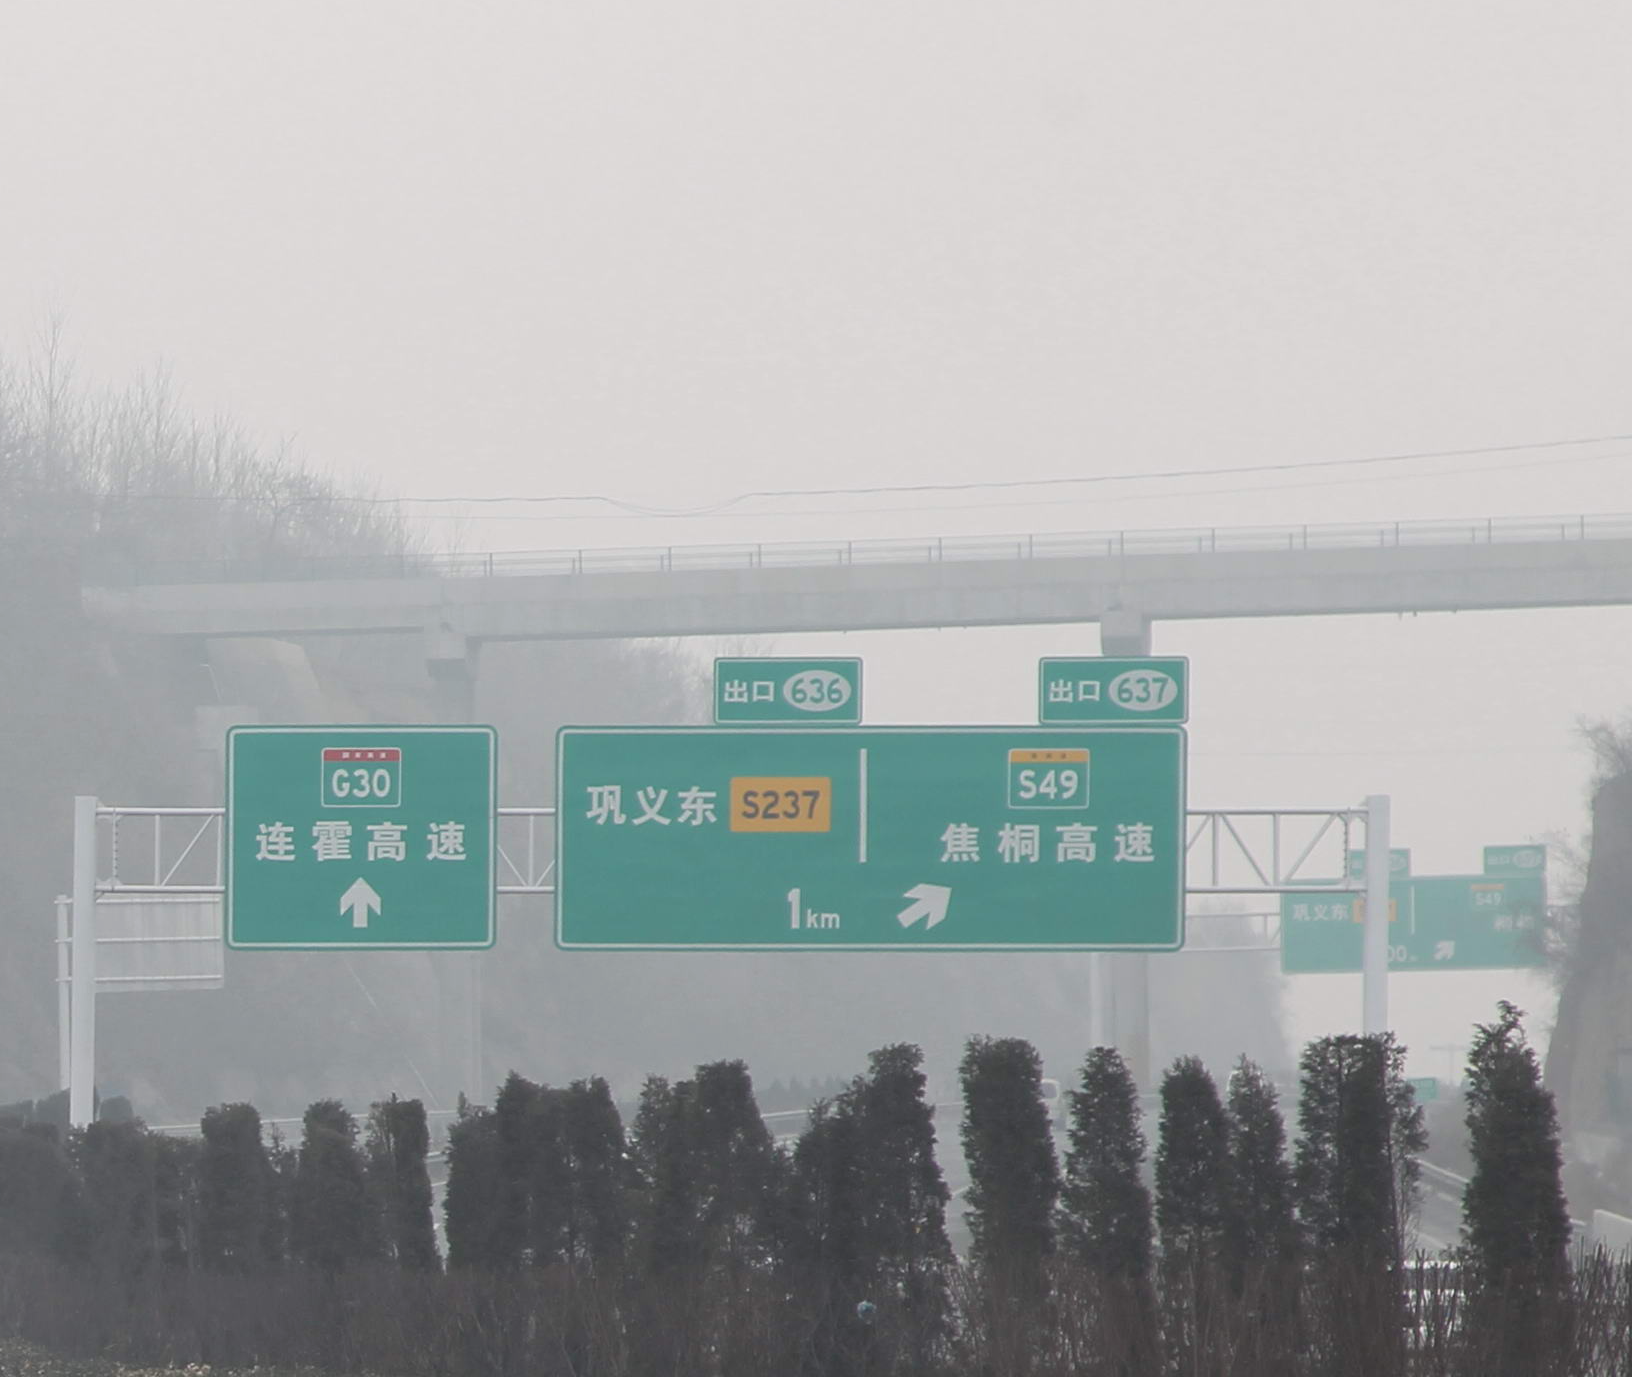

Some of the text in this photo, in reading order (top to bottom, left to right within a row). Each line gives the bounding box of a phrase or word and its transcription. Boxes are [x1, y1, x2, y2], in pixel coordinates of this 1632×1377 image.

[723, 678, 844, 704] 出口 636
[1049, 678, 1168, 704] 出口 637
[331, 768, 391, 798] G30
[1019, 769, 1079, 799] S49
[585, 785, 821, 826] 巩义东 S237
[255, 821, 468, 862] 连霍高速
[940, 823, 1155, 863] 焦桐高速
